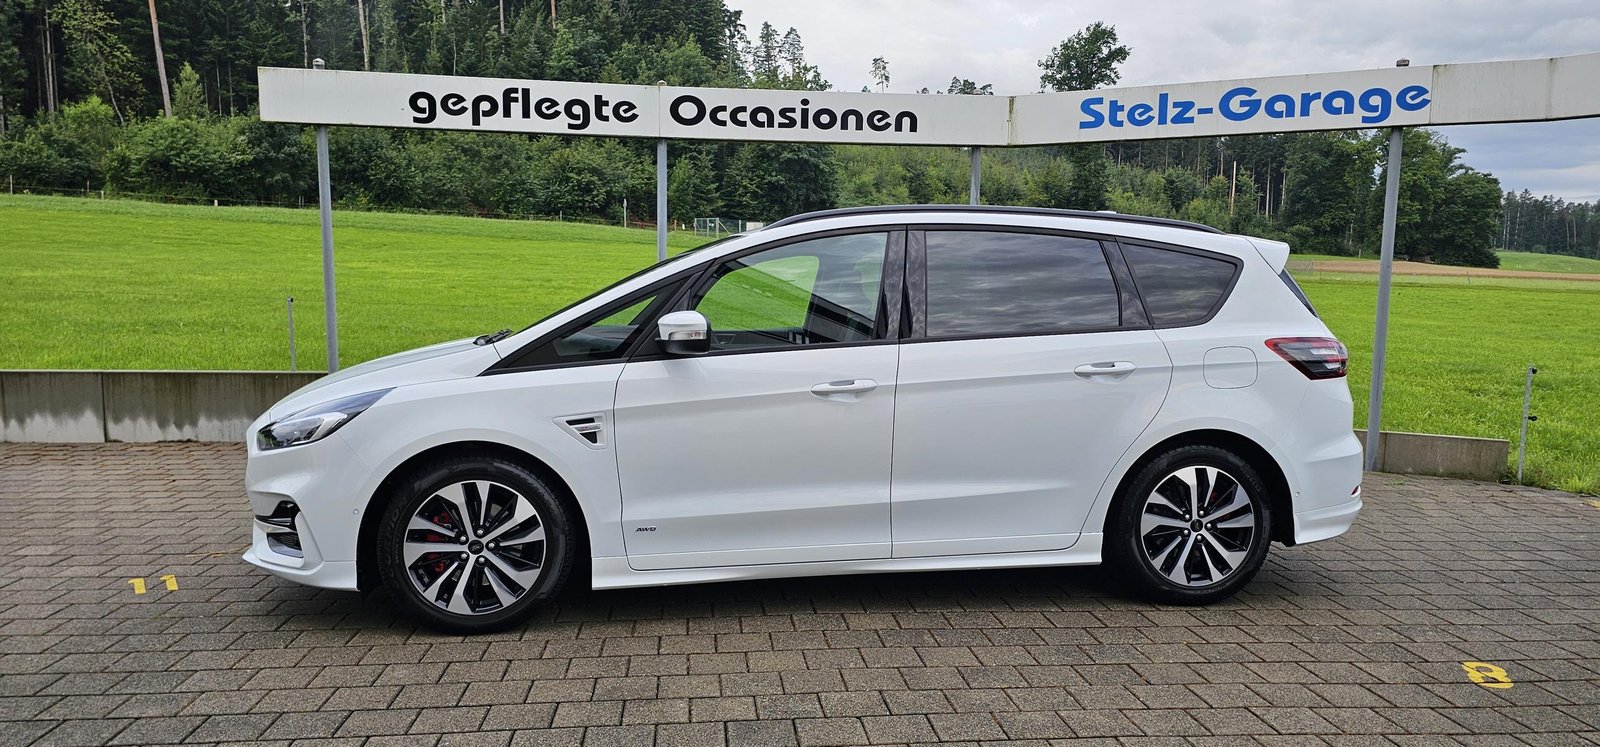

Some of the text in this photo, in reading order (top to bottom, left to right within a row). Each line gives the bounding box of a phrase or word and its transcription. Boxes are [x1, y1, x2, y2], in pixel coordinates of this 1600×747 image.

[408, 87, 919, 133] gepflegte Occasionen
[1079, 85, 1431, 129] Stelz-Garage
